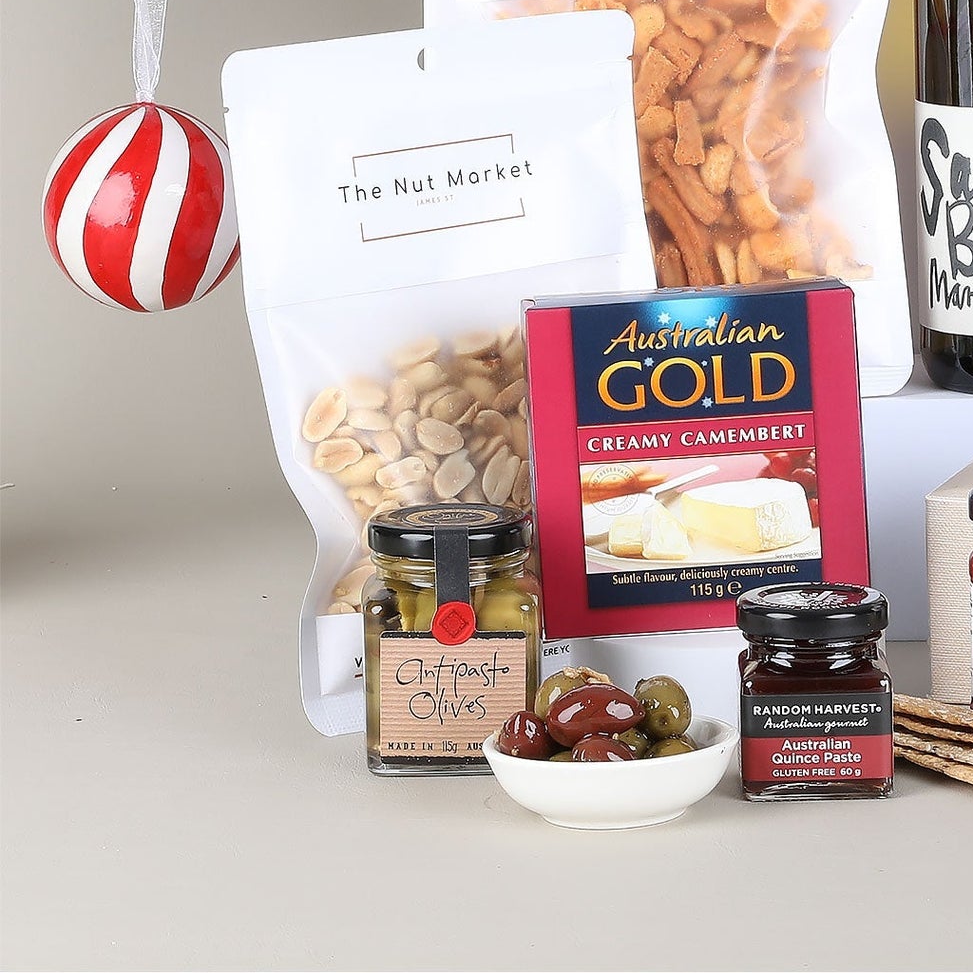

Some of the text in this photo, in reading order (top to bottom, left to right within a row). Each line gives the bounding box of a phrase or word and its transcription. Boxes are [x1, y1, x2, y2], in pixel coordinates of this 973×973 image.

[338, 160, 532, 203] The Nut Market
[603, 312, 784, 356] Australian
[598, 352, 796, 411] GOLD
[587, 424, 806, 453] CREAMY CAMEMBERT
[612, 564, 799, 585] Subtle flavour, deliciously creamy centre.
[690, 584, 712, 596] 115
[716, 586, 724, 597] g
[408, 688, 486, 725] Olives
[753, 705, 811, 715] RANDOM
[764, 717, 868, 733] Australian gourmet
[442, 741, 457, 753] 115g
[782, 738, 851, 751] Australian
[772, 752, 862, 765] Quince Paste
[772, 769, 809, 777] GLUTEN
